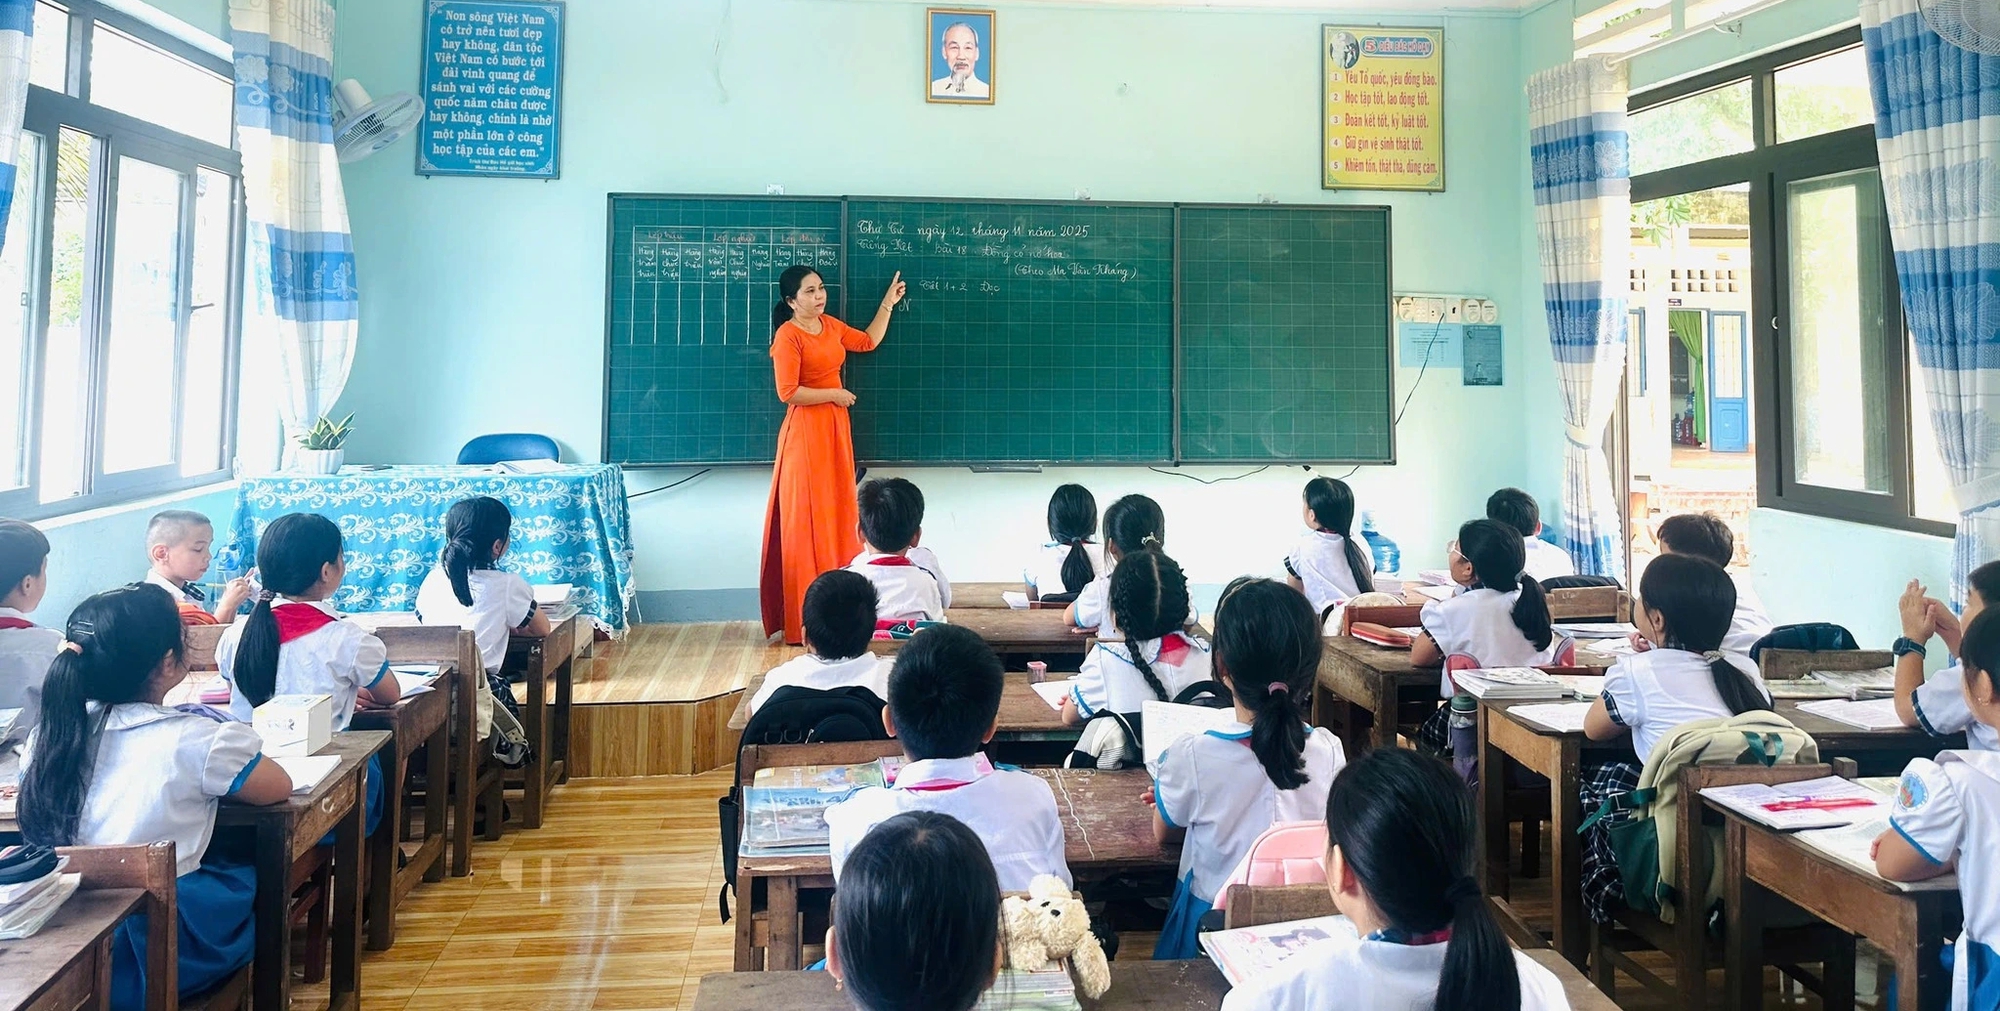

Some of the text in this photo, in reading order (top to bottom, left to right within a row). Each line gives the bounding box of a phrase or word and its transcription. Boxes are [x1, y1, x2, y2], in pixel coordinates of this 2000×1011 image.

[445, 10, 466, 21] Non
[469, 12, 494, 25] sông
[497, 12, 519, 26] Việt
[522, 14, 545, 25] Nam
[440, 24, 453, 34] có
[456, 24, 473, 35] trở
[475, 26, 496, 37] nên
[499, 27, 520, 38] tươi
[442, 38, 543, 55] hay không, dân tộc
[1364, 40, 1376, 52] 5
[434, 52, 546, 68] Việt Nam có bước tới
[462, 67, 485, 79] vinh
[488, 70, 520, 83] quang
[1345, 70, 1358, 84] Yêu
[1370, 69, 1389, 87] quốc,
[1390, 71, 1403, 87] yêu
[431, 81, 552, 100] sánh vai với các cường
[1333, 89, 1430, 109] 2 Học tập tốt, lao động tốt.
[434, 94, 547, 112] quốc năm châu được
[429, 110, 552, 126] hay không, chính là nhờ
[1333, 116, 1339, 124] 3
[1345, 113, 1363, 127] Đoàn
[1364, 112, 1376, 127] kết
[1377, 112, 1390, 129] tốt,
[1401, 113, 1415, 131] luật
[1416, 113, 1429, 128] tốt.
[432, 127, 543, 145] một phần lớn ở công
[1333, 139, 1338, 147] 4
[1370, 137, 1378, 153] vệ
[1380, 136, 1395, 150] sinh
[1396, 136, 1411, 154] thật
[1411, 135, 1424, 151] tốt.
[432, 143, 452, 156] học
[455, 143, 474, 158] tập
[476, 144, 495, 156] của
[498, 145, 517, 156] các
[1333, 161, 1339, 170] 5
[1345, 157, 1364, 173] Khiêm
[1365, 156, 1378, 174] tốn,
[1379, 158, 1392, 176] thật
[1406, 158, 1421, 176] dũng
[917, 223, 946, 243] ngày
[950, 225, 964, 236] 12
[972, 221, 1009, 243] tháng
[1011, 226, 1021, 236] 11
[1028, 226, 1056, 237] năm
[1060, 224, 1090, 238] 2025
[857, 235, 888, 258] Tiếng
[957, 246, 967, 255] 18
[1045, 246, 1066, 259] hoa
